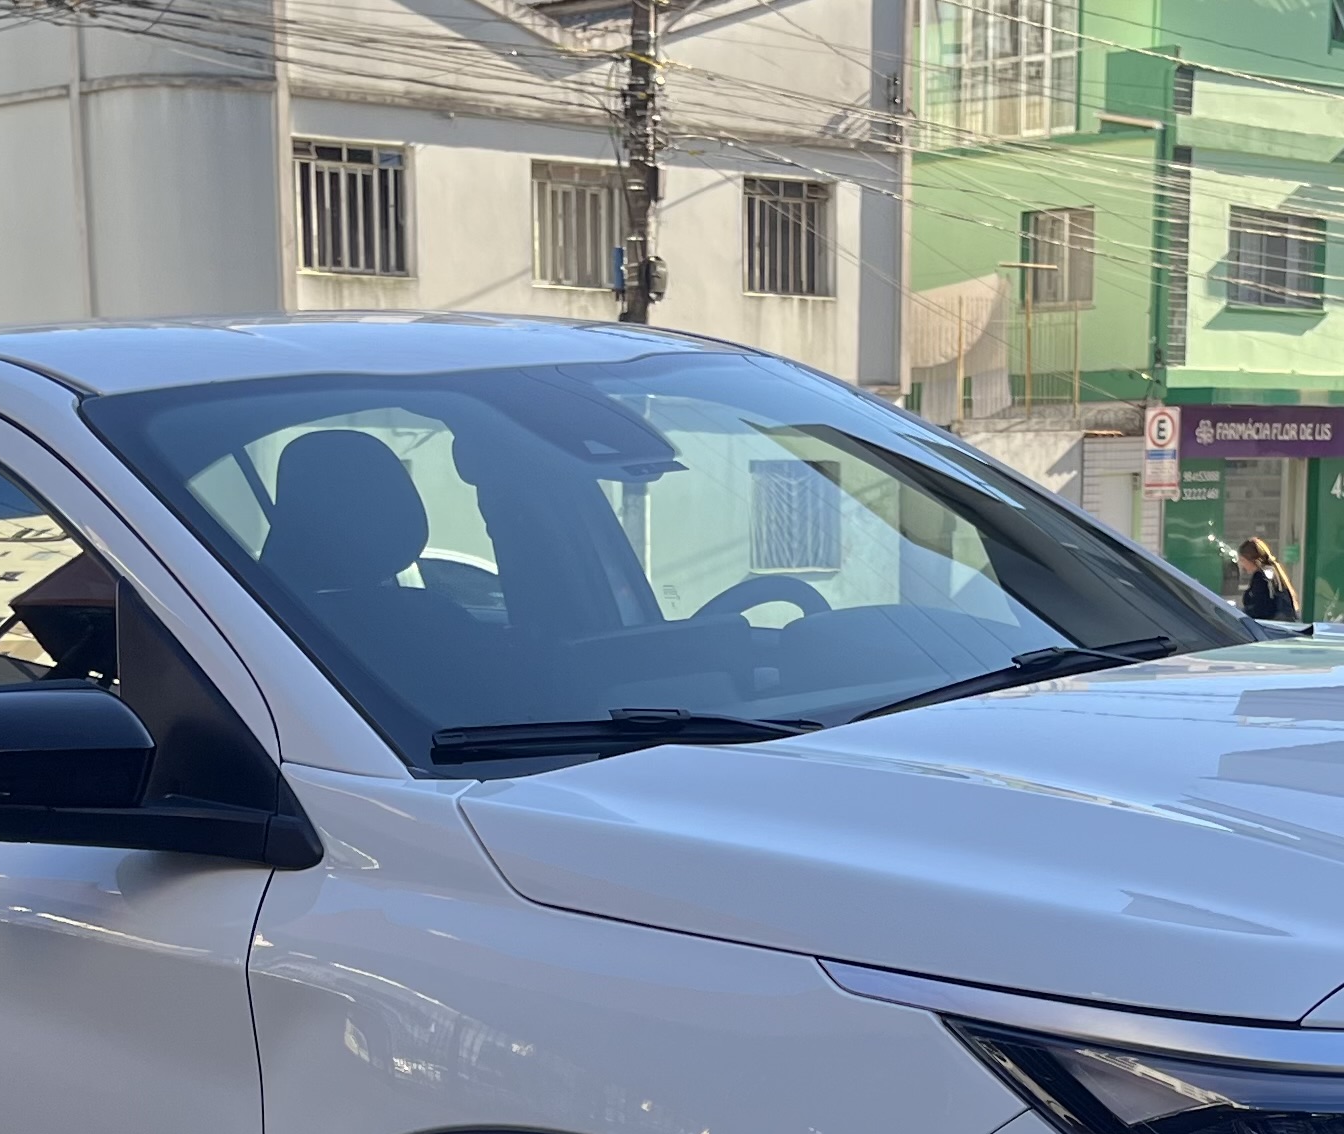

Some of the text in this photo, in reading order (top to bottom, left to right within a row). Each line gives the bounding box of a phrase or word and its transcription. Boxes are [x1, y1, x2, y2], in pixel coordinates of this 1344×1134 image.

[1157, 419, 1166, 440] E
[1216, 417, 1333, 441] FARMÁCIA FLOR DE LIS
